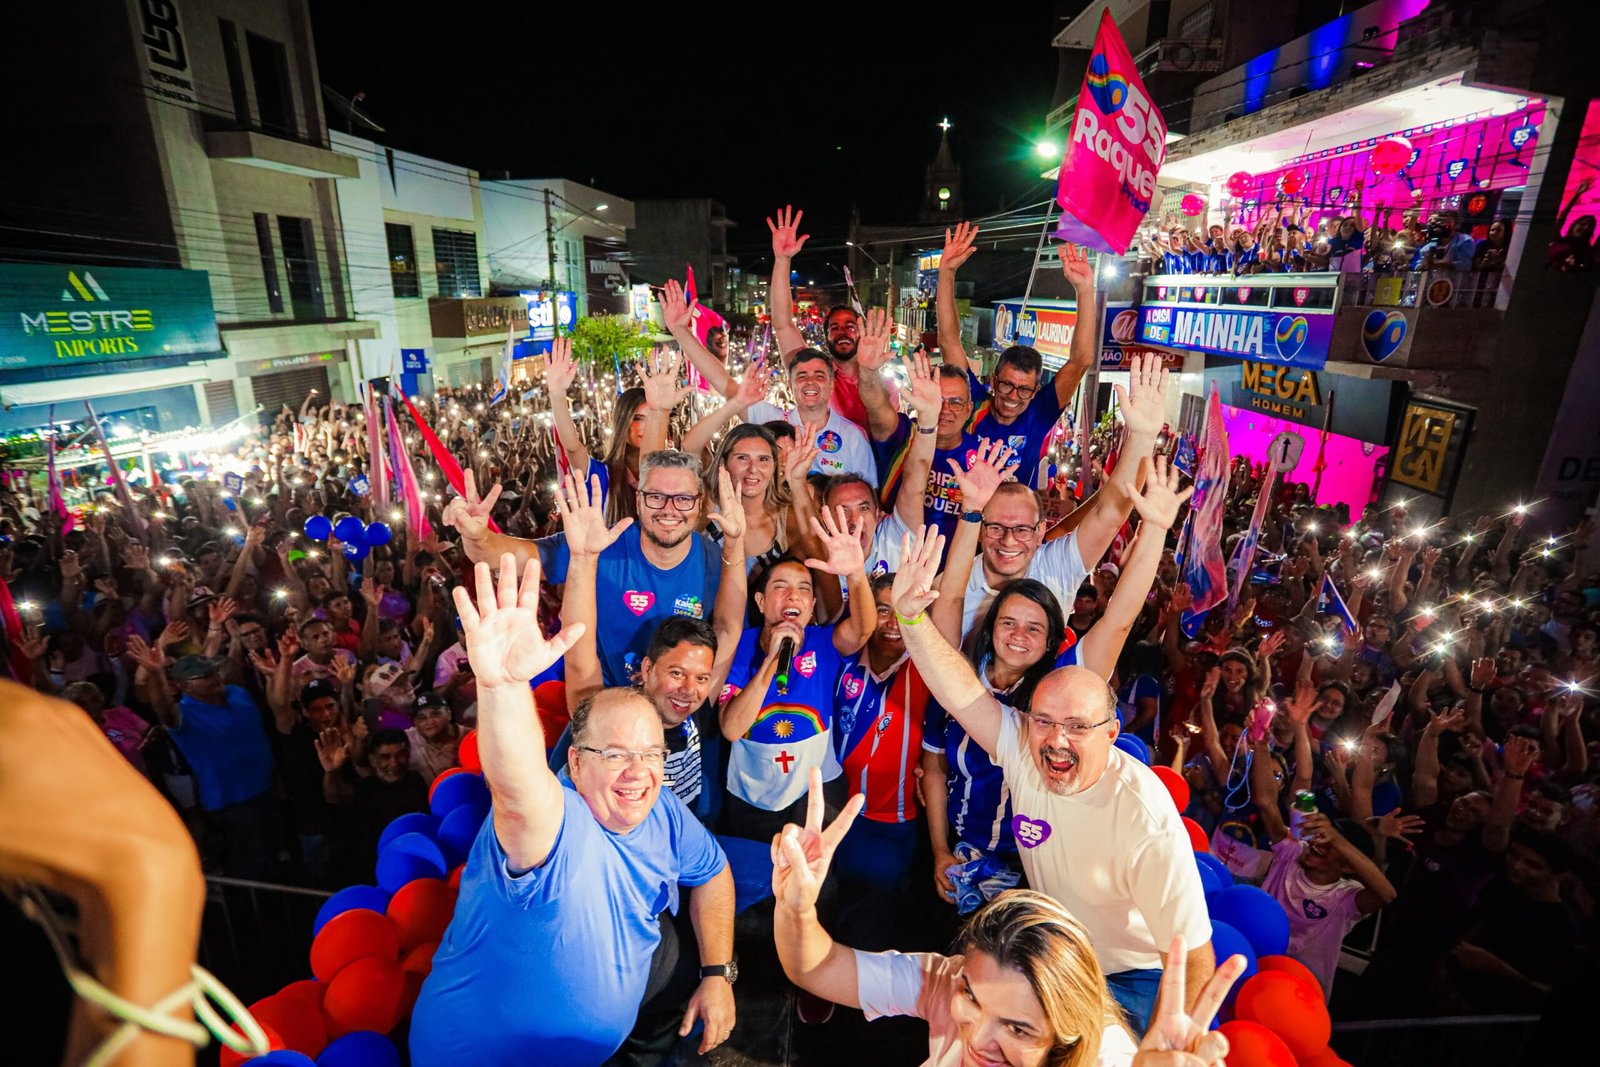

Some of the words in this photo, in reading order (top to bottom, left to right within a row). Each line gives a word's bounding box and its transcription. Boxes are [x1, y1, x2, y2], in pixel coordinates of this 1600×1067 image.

[1116, 83, 1166, 166] 55
[20, 310, 153, 334] MESTRE
[1152, 308, 1171, 323] CASA
[1150, 325, 1163, 341] DE
[1174, 311, 1264, 355] MAINHA
[54, 336, 139, 359] IMPORTS
[1241, 360, 1322, 406] MEGA
[1252, 397, 1304, 419] HOMEM
[630, 594, 649, 607] 55
[1018, 820, 1043, 841] 55
